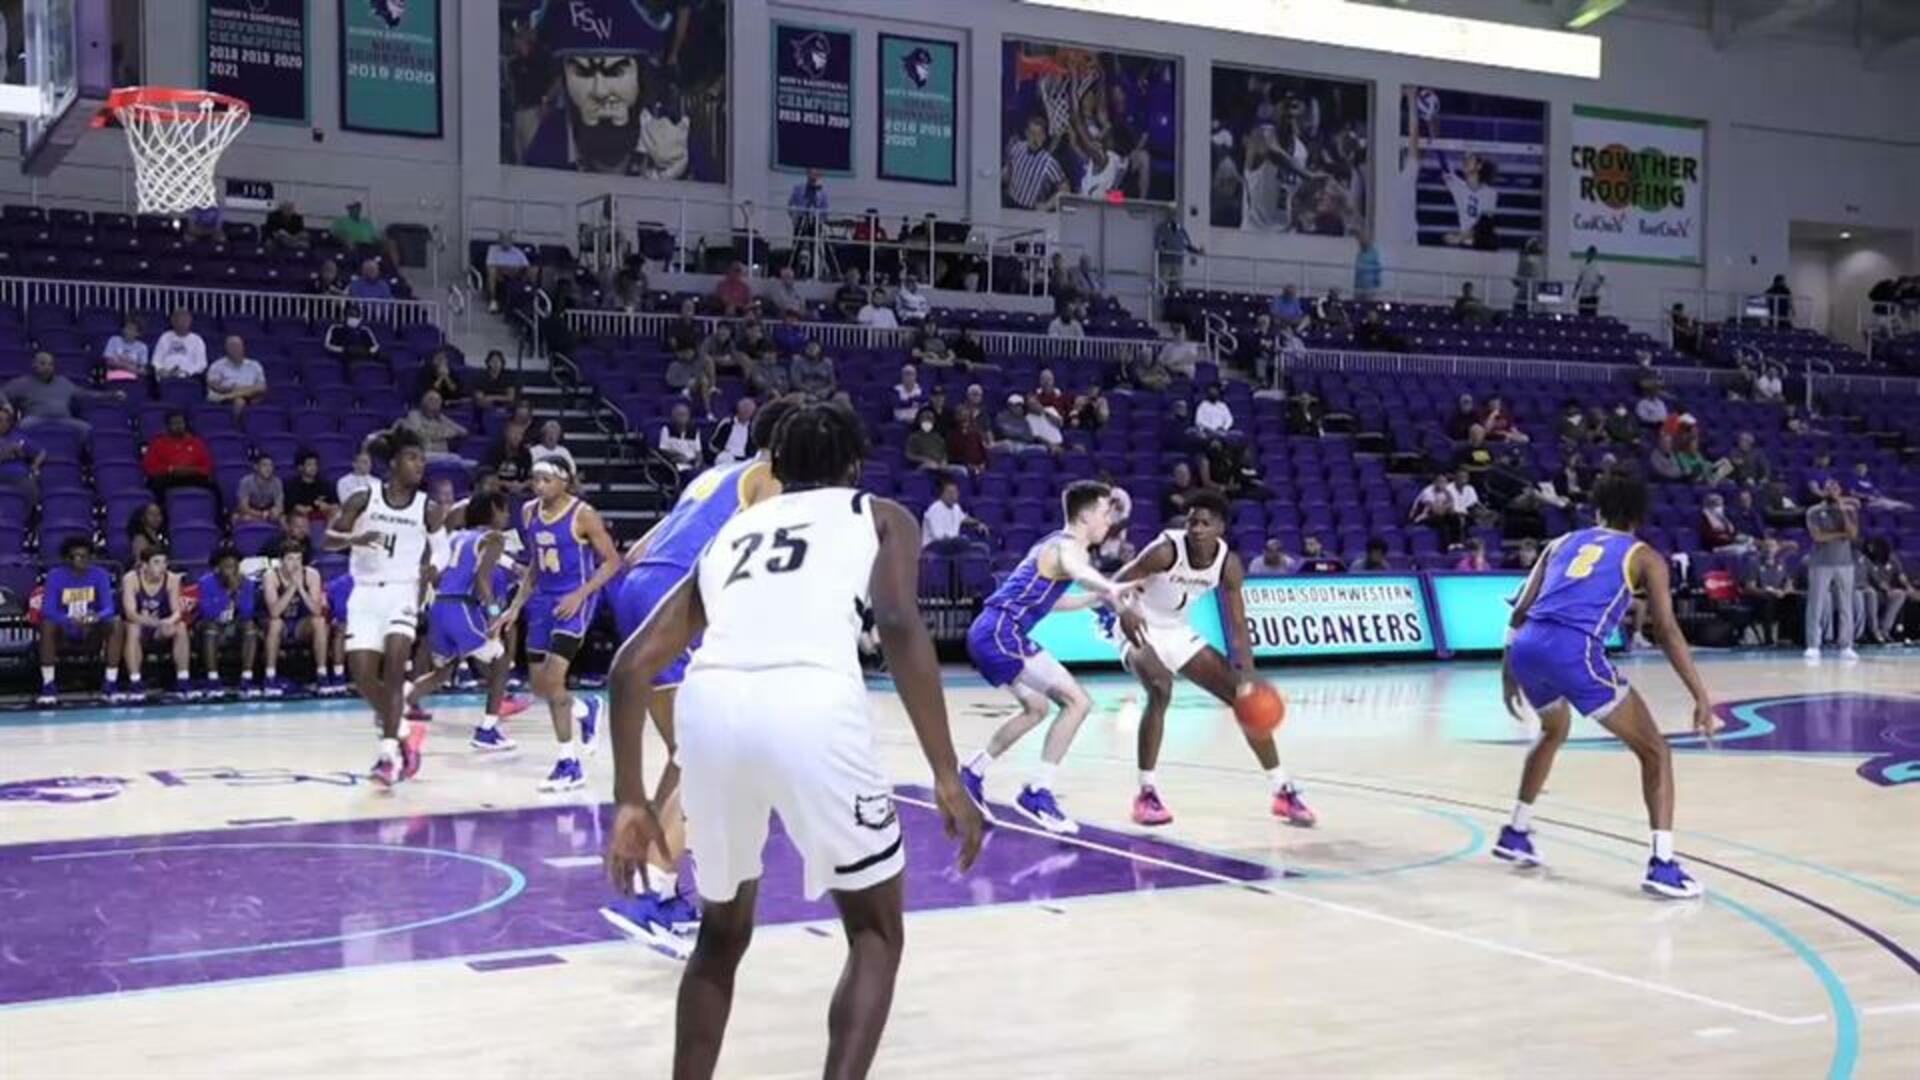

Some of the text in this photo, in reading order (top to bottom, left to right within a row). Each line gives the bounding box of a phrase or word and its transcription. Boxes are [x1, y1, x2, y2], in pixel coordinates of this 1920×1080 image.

[570, 0, 613, 40] FSW
[1571, 145, 1698, 184] CROWTHER
[1580, 176, 1686, 210] ROOFING
[383, 533, 397, 559] 4
[722, 522, 815, 590] 25
[1566, 543, 1604, 579] 2
[1299, 586, 1412, 602] SOUTHWESTERN
[1246, 612, 1423, 647] BUCCANEERS
